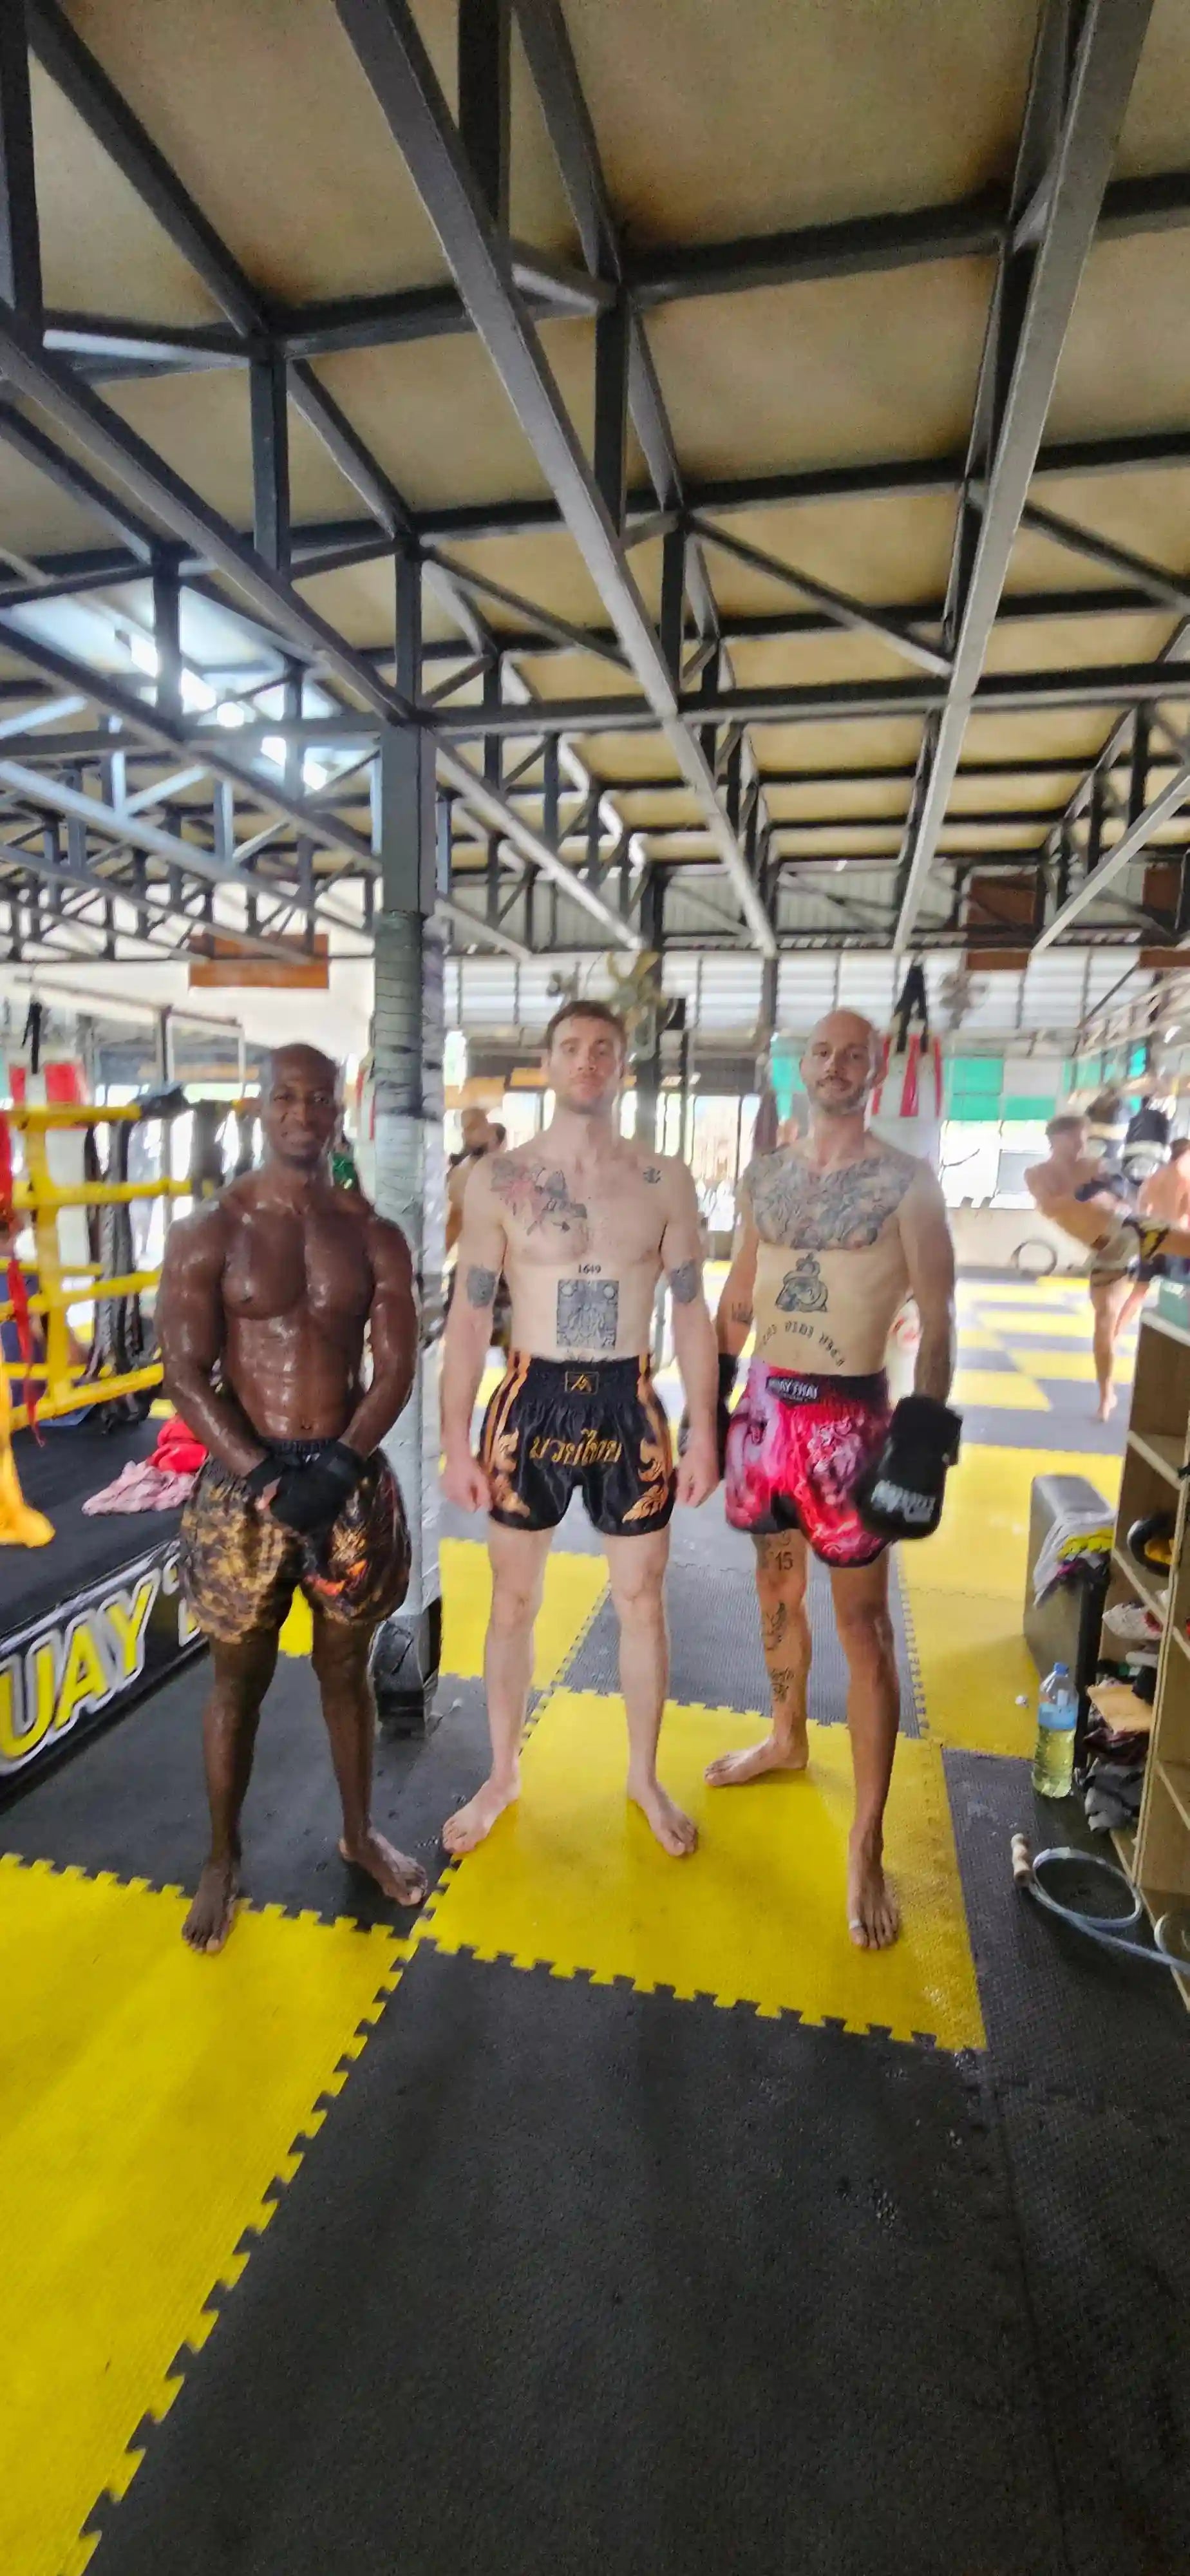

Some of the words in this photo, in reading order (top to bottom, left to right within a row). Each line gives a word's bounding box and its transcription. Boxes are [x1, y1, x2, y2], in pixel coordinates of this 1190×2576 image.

[529, 1428, 623, 1466] มวยไทย
[775, 1550, 794, 1571] 15
